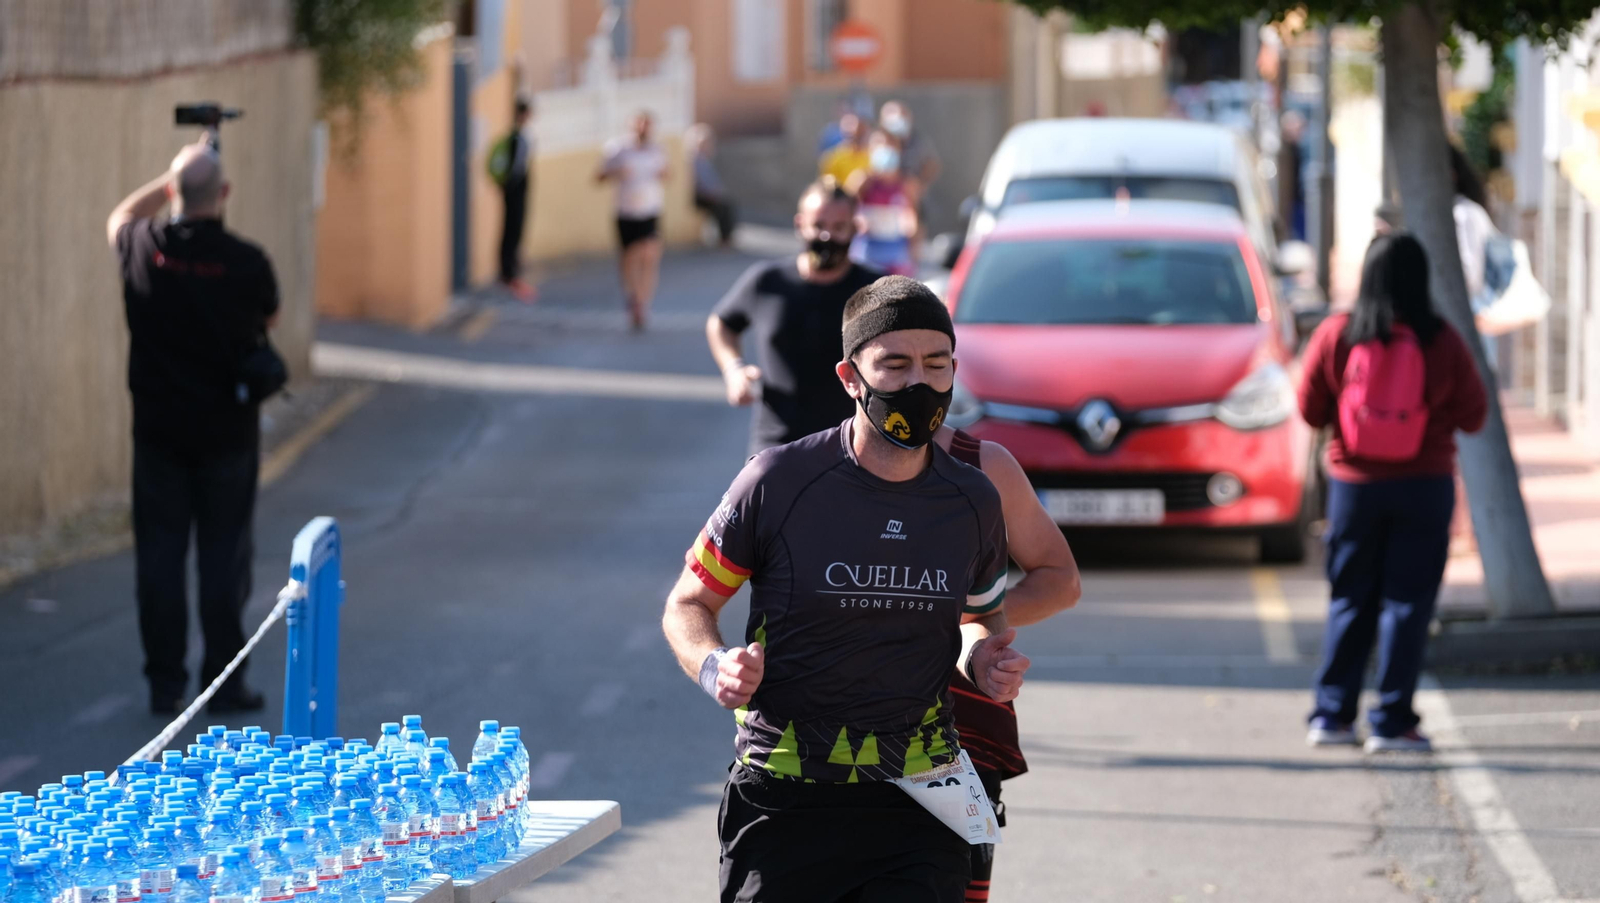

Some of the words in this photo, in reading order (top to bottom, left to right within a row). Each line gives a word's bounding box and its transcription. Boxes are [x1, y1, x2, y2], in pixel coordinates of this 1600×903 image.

[825, 561, 950, 593] CUELLAR
[840, 598, 893, 609] STONE
[900, 600, 934, 612] 1958
